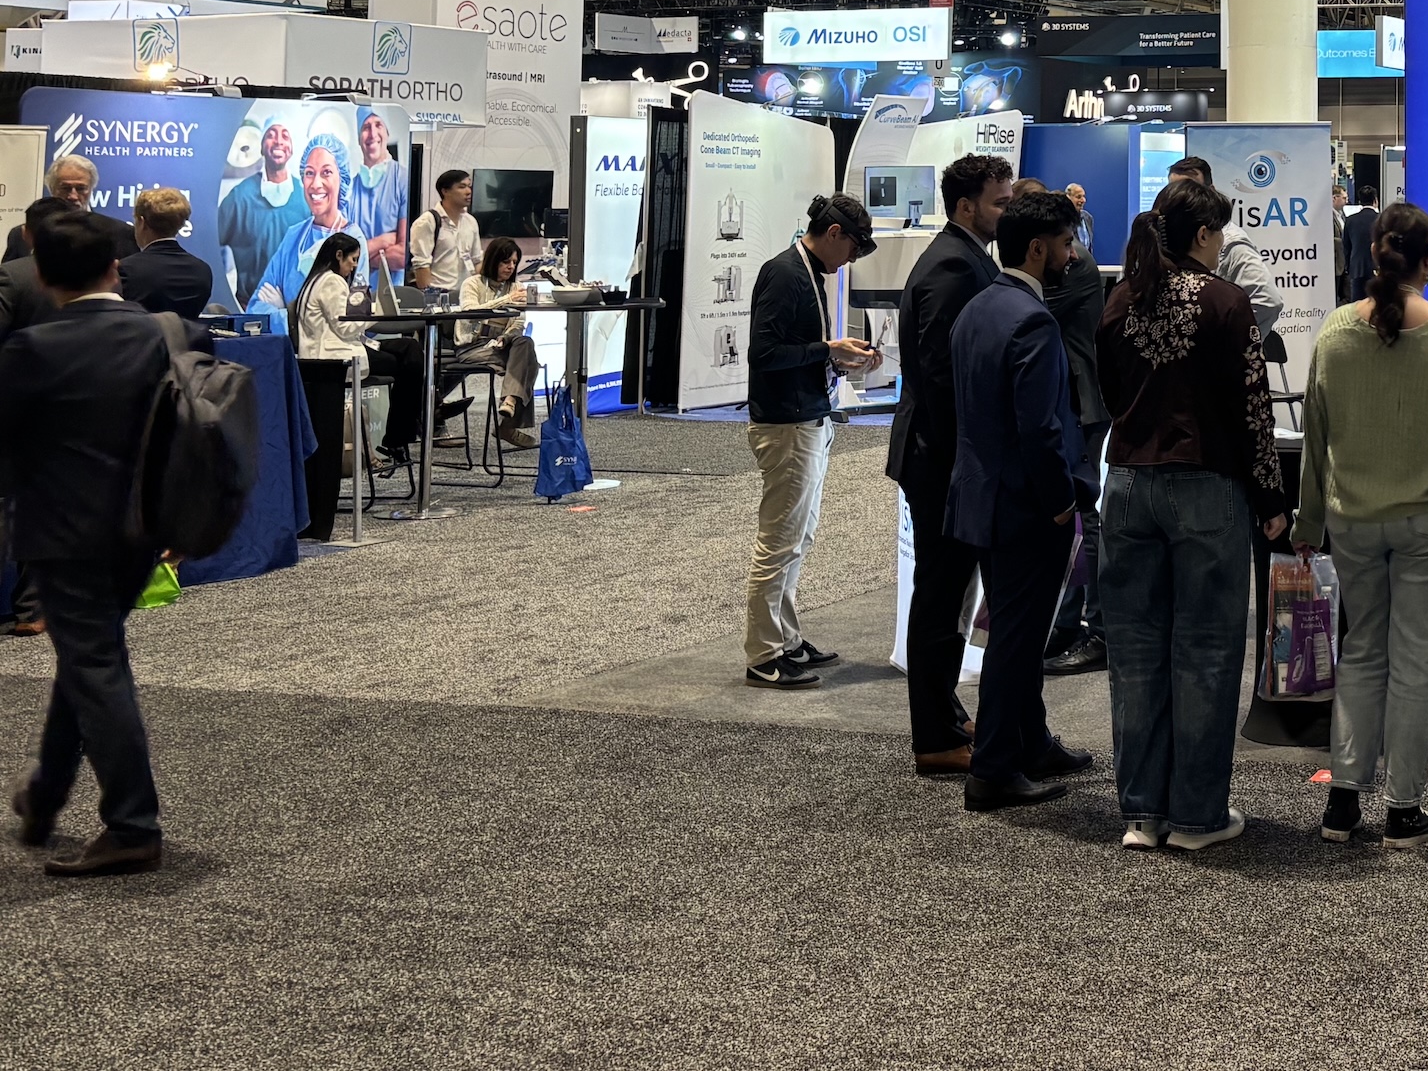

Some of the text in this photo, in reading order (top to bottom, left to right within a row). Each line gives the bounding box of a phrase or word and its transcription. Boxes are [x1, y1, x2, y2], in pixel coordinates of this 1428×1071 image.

[457, 0, 568, 42] esaote
[656, 28, 692, 38] Medacta
[806, 25, 926, 44] MIZUHO OSI
[1139, 33, 1179, 41] Transforming
[507, 41, 526, 53] WITH
[527, 43, 547, 55] CARE
[530, 73, 545, 83] MRI
[397, 81, 463, 102] ORTHO
[511, 101, 559, 114] Economical.
[1145, 104, 1172, 112] SYSTEMS
[416, 111, 465, 124] SURGICAL
[488, 115, 532, 128] Accessible.
[85, 119, 194, 143] SYNERGY
[703, 131, 759, 144] Dedicated Orthopedic
[976, 123, 1015, 144] HiRise
[85, 146, 194, 157] HEALTH PARTNERS
[700, 145, 761, 158] Cone Beam CT Imaging
[595, 184, 629, 197] Flexible
[1294, 307, 1326, 319] Reality
